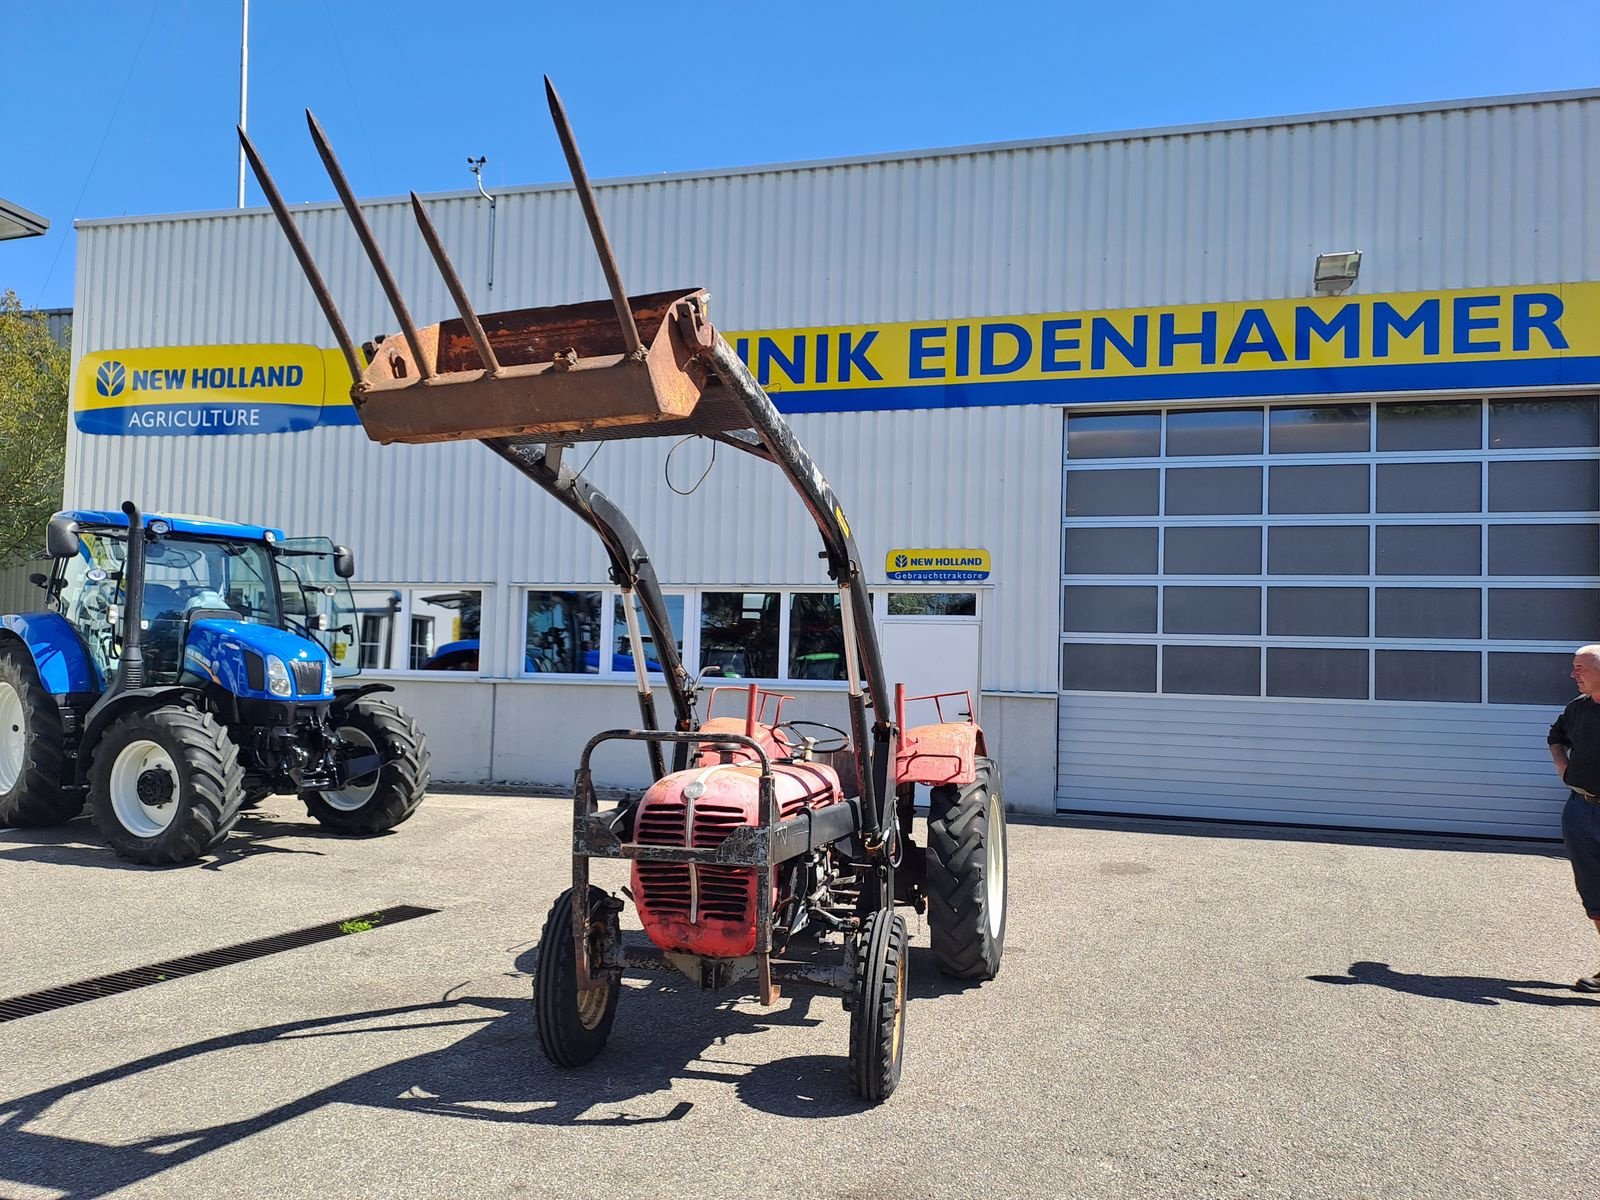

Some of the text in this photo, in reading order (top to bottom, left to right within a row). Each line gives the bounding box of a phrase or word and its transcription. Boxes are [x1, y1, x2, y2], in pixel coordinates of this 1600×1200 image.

[909, 293, 1569, 379] EIDENHAMMER
[132, 365, 304, 390] NEW HOLLAND
[128, 408, 260, 428] AGRICULTURE
[911, 557, 982, 566] NEW HOLLAND
[895, 571, 983, 579] Gebrauchttraktore
